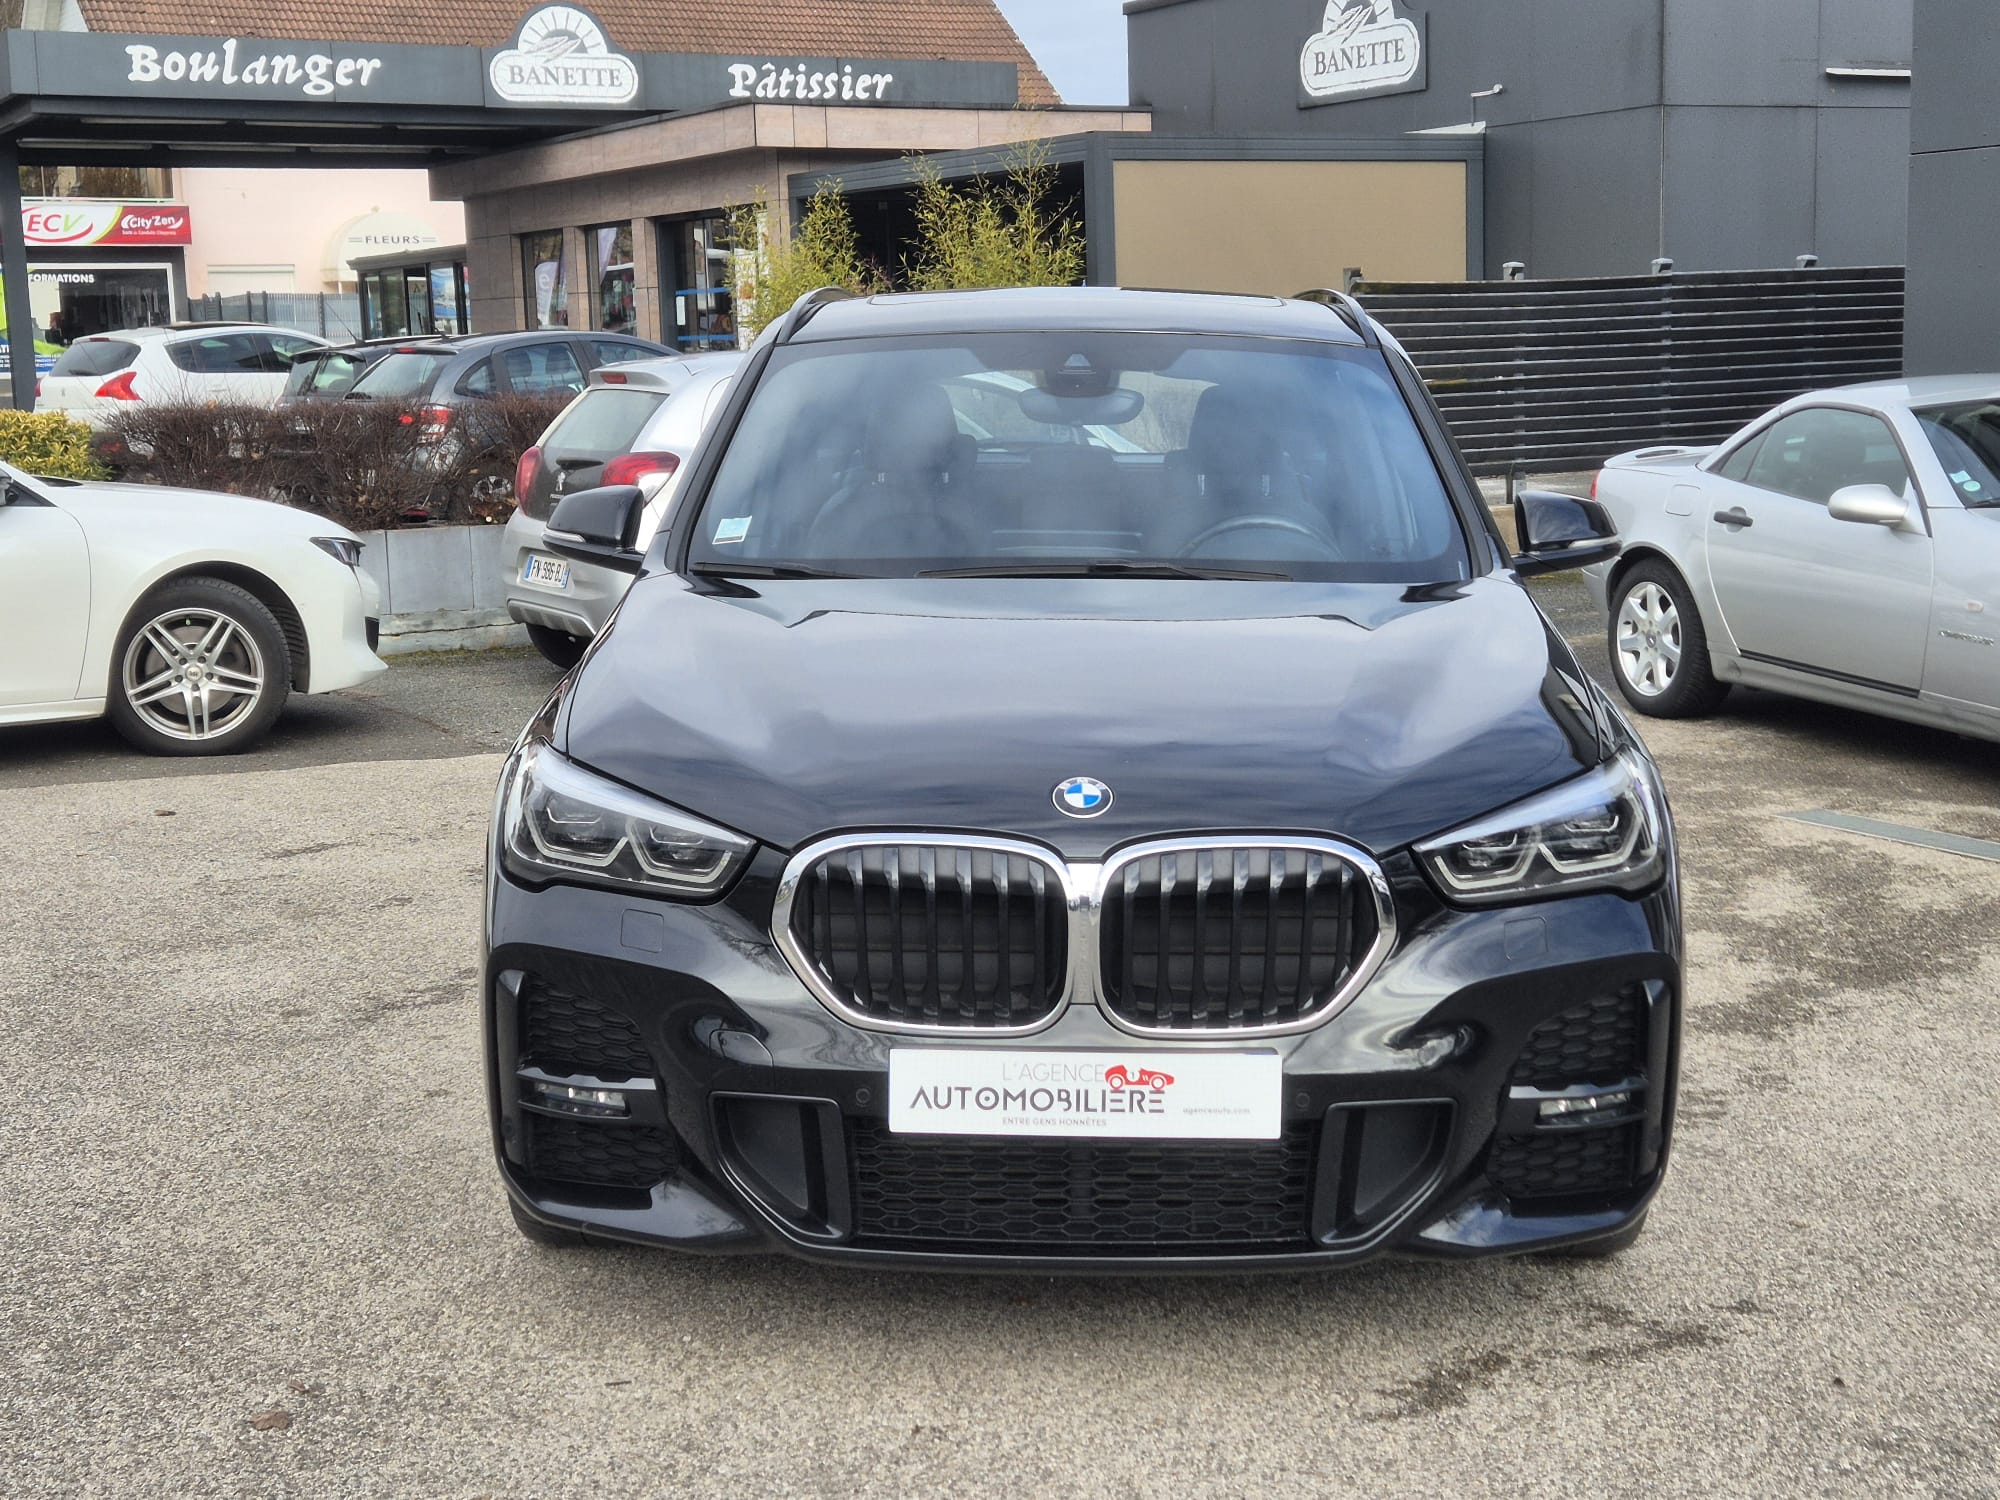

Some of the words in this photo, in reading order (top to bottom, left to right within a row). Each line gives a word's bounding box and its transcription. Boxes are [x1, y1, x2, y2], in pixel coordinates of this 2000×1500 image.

[125, 38, 381, 95] Boulanger
[1314, 38, 1406, 76] BANETTE
[508, 64, 623, 88] BANETTE
[728, 62, 893, 100] Pâtissier
[27, 214, 85, 233] ECV
[365, 235, 421, 244] FLEURS
[1002, 1063, 1105, 1082] L'AGENCE
[1002, 1117, 1030, 1126] ENTRE
[1032, 1117, 1057, 1126] GENS
